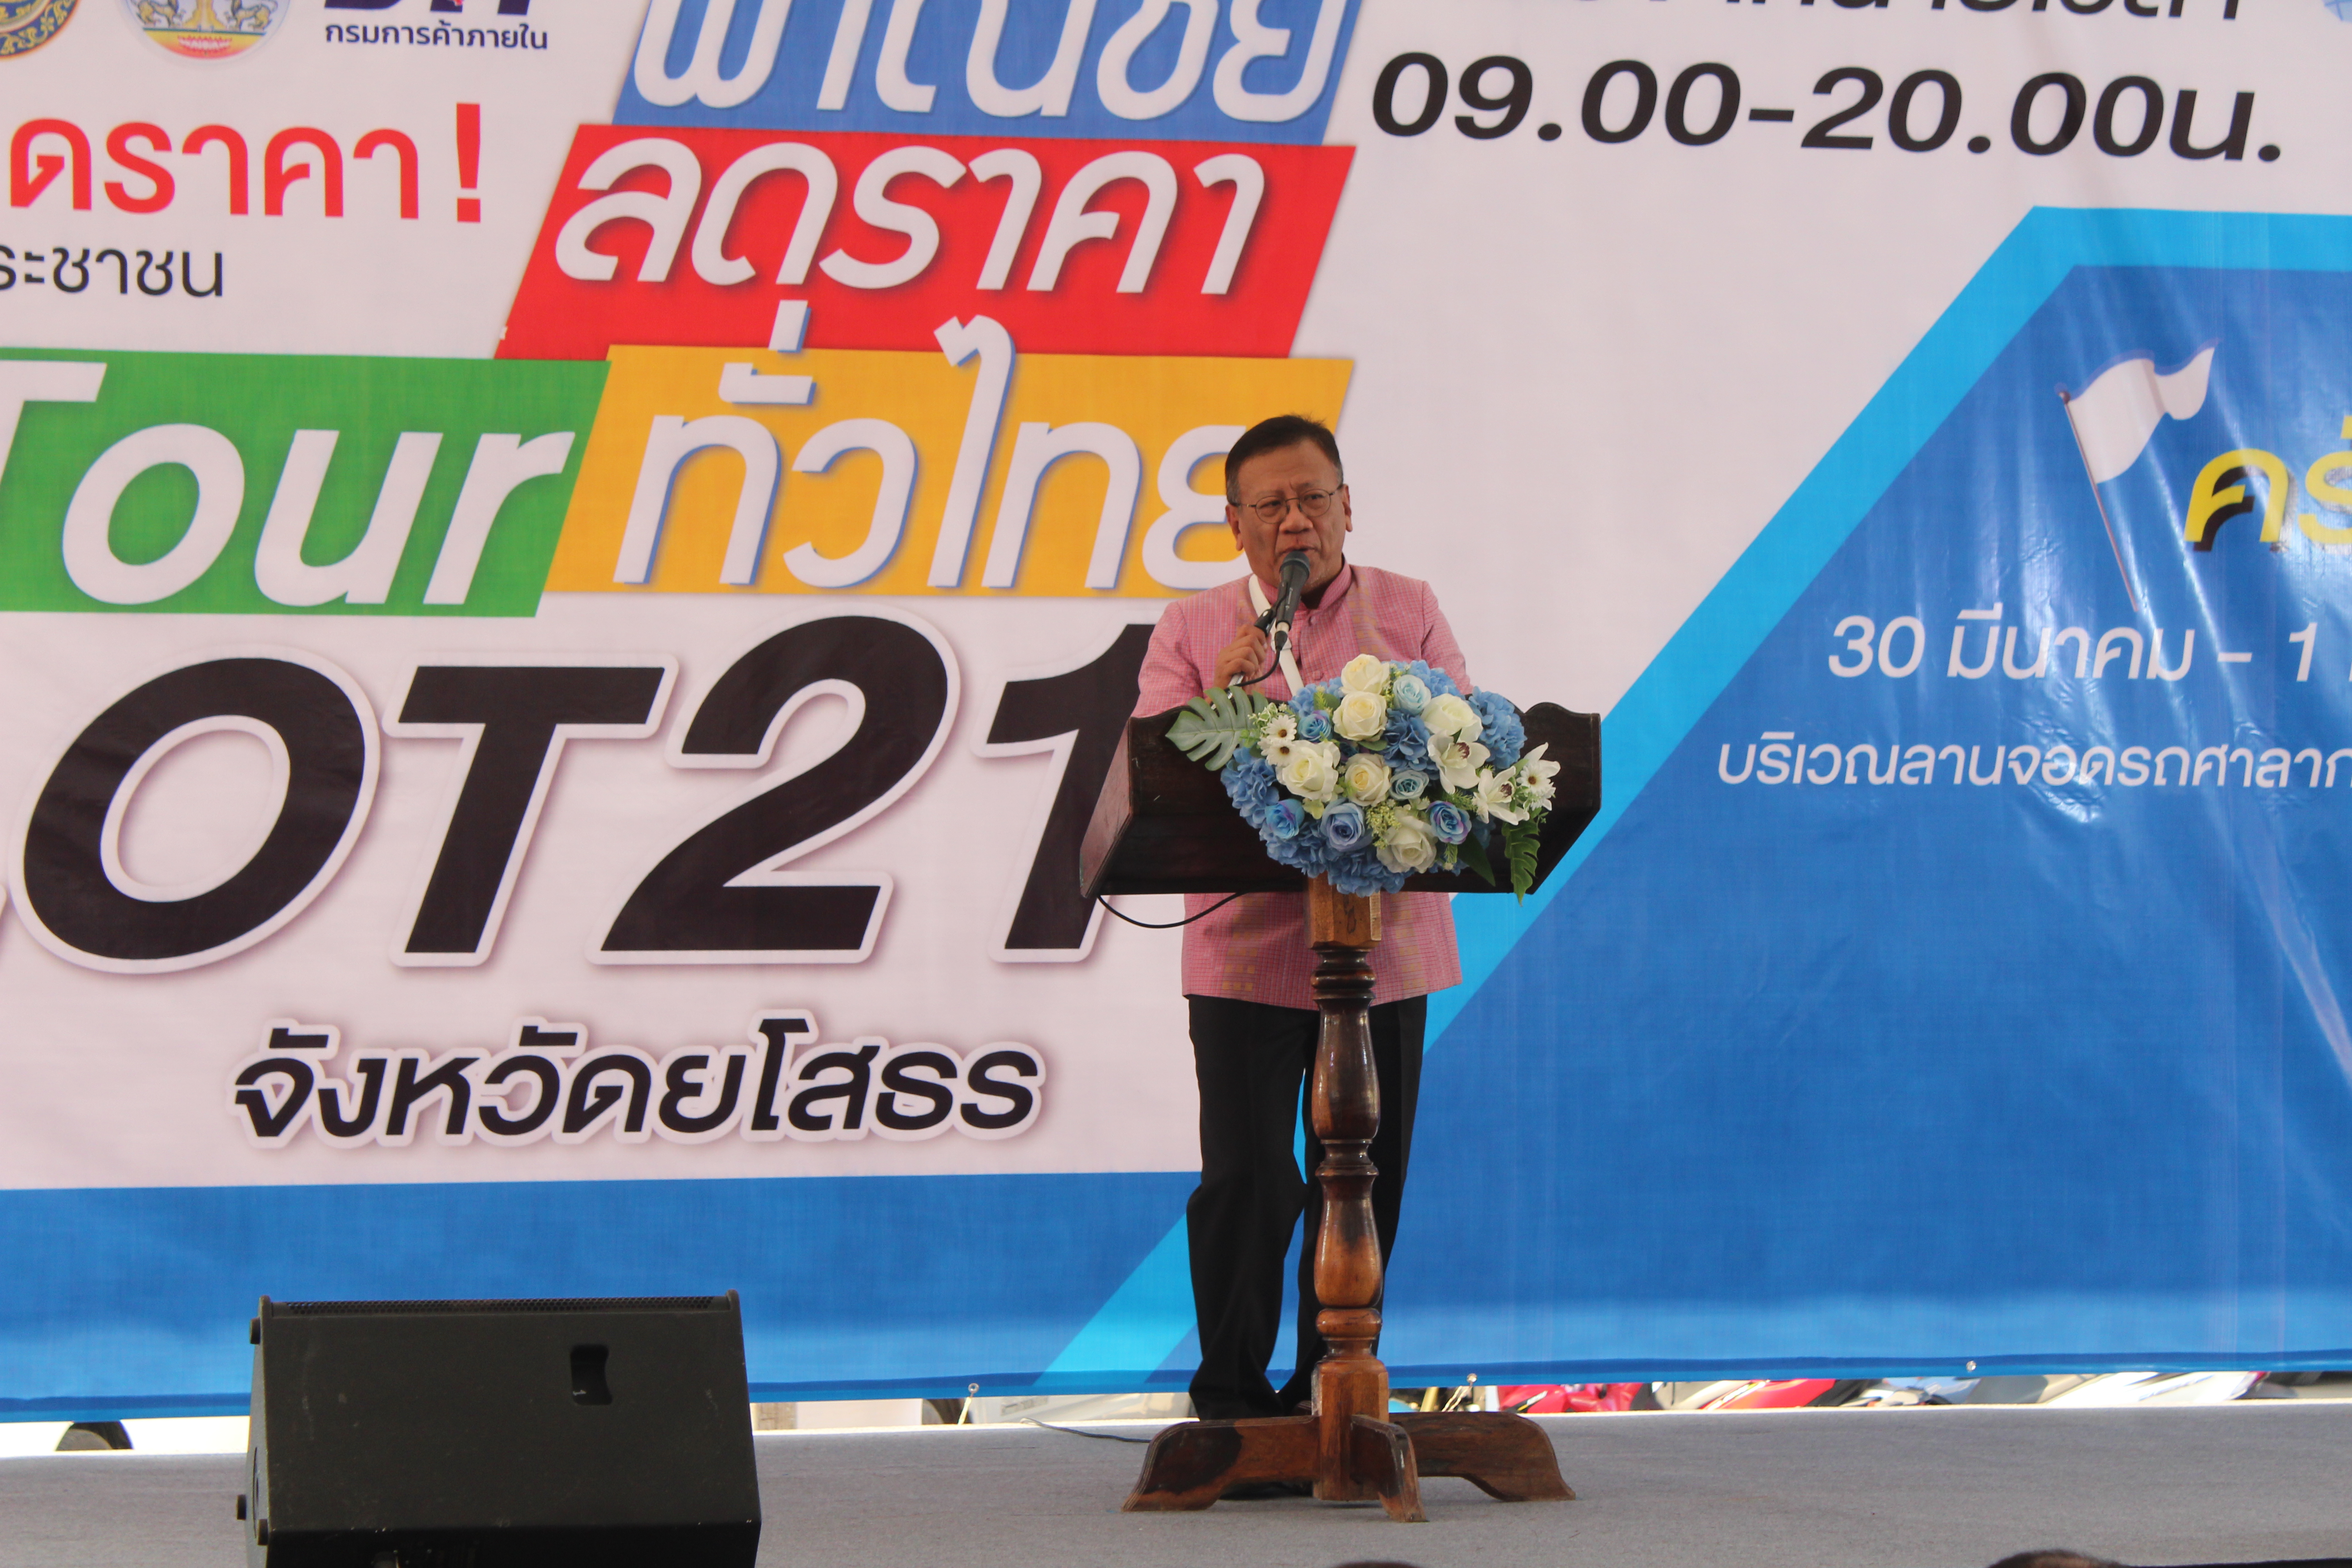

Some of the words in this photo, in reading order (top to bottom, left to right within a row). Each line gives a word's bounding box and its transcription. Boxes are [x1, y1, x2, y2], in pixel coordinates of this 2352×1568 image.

[325, 20, 547, 49] กรมการค้าภายใน
[1372, 51, 2281, 162] 09.00-20.00น.
[555, 137, 1264, 294] ลดราคา
[1828, 615, 1926, 678] 30
[1947, 602, 2195, 681] มีนาคม
[2289, 622, 2318, 681] 1
[1718, 731, 2352, 789] บริเวณลานจอดรถศาลาก
[235, 1018, 1039, 1137] จังหวัดยโสธร
